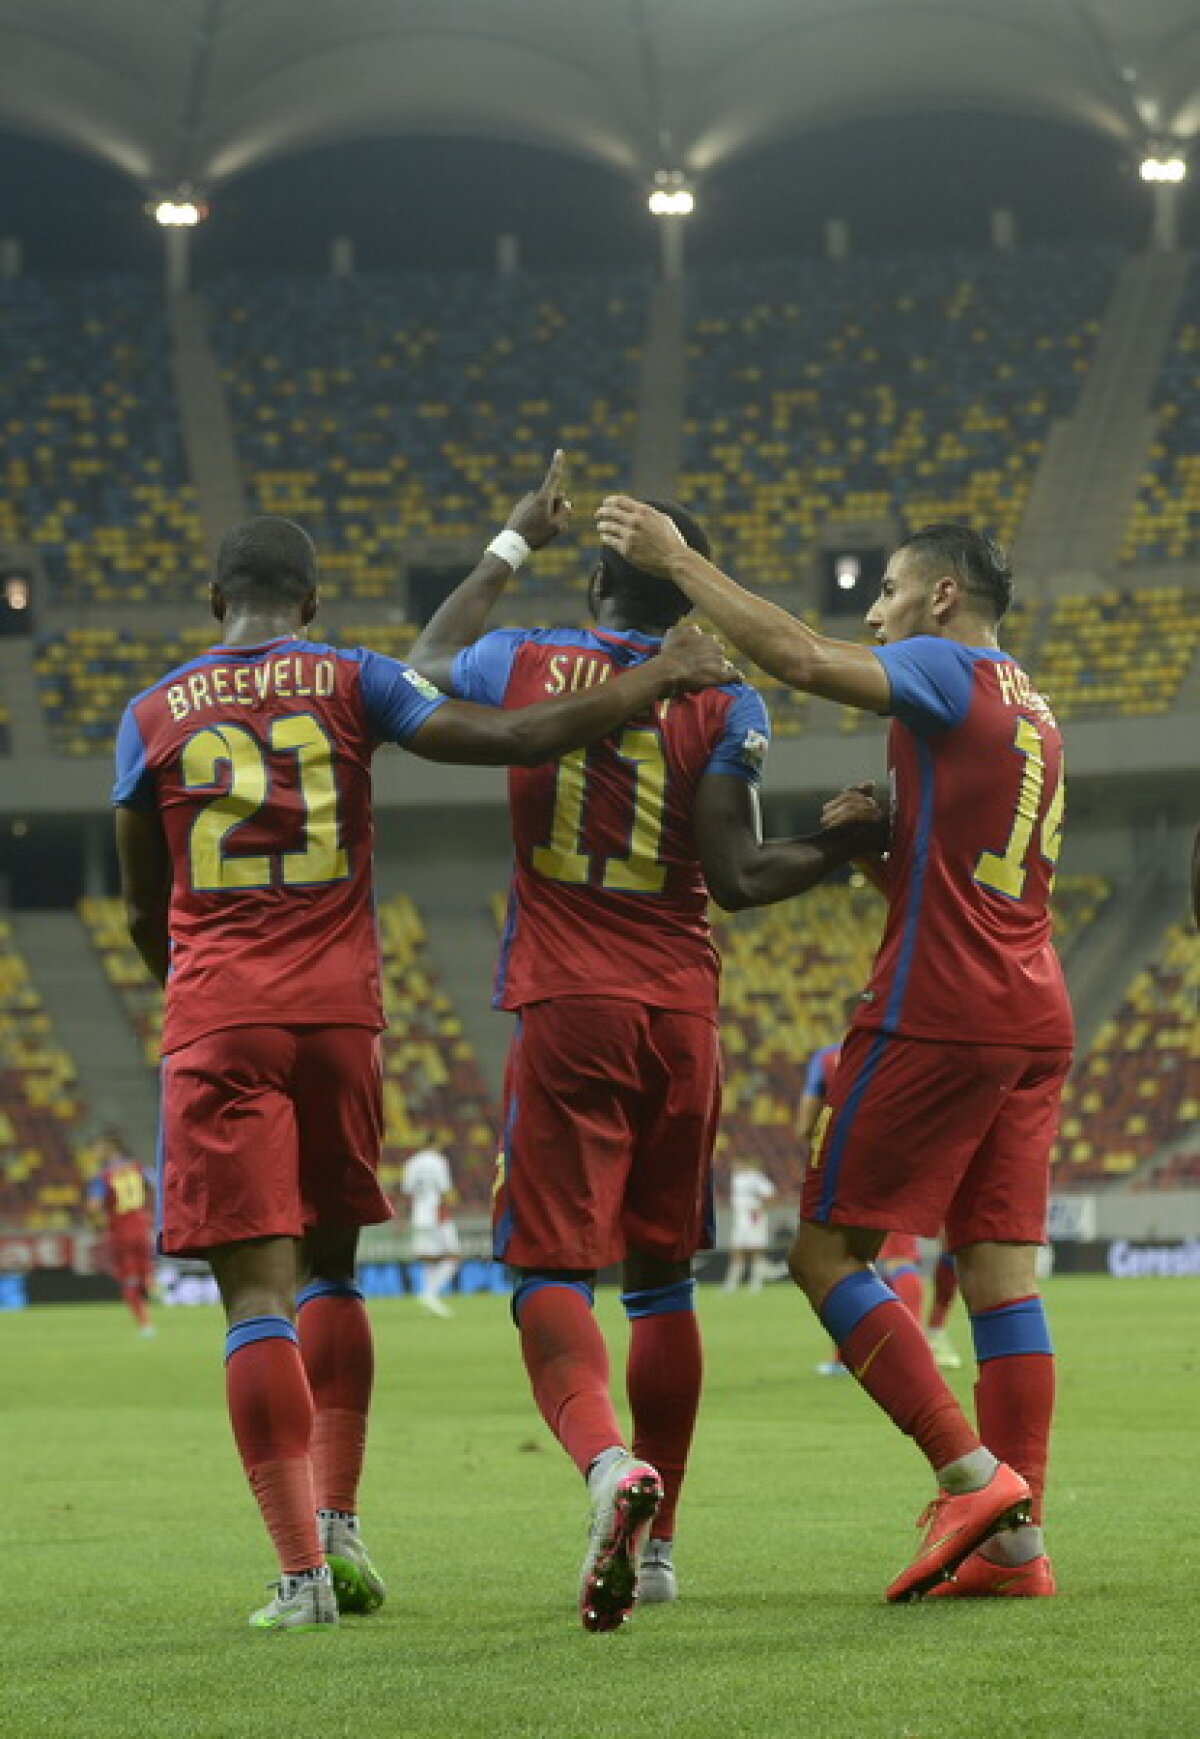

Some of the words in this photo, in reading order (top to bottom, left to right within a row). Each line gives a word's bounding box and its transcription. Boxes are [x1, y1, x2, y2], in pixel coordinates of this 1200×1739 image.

[166, 656, 334, 722] BREEVELD
[181, 711, 350, 892] 21
[531, 727, 668, 892] 11
